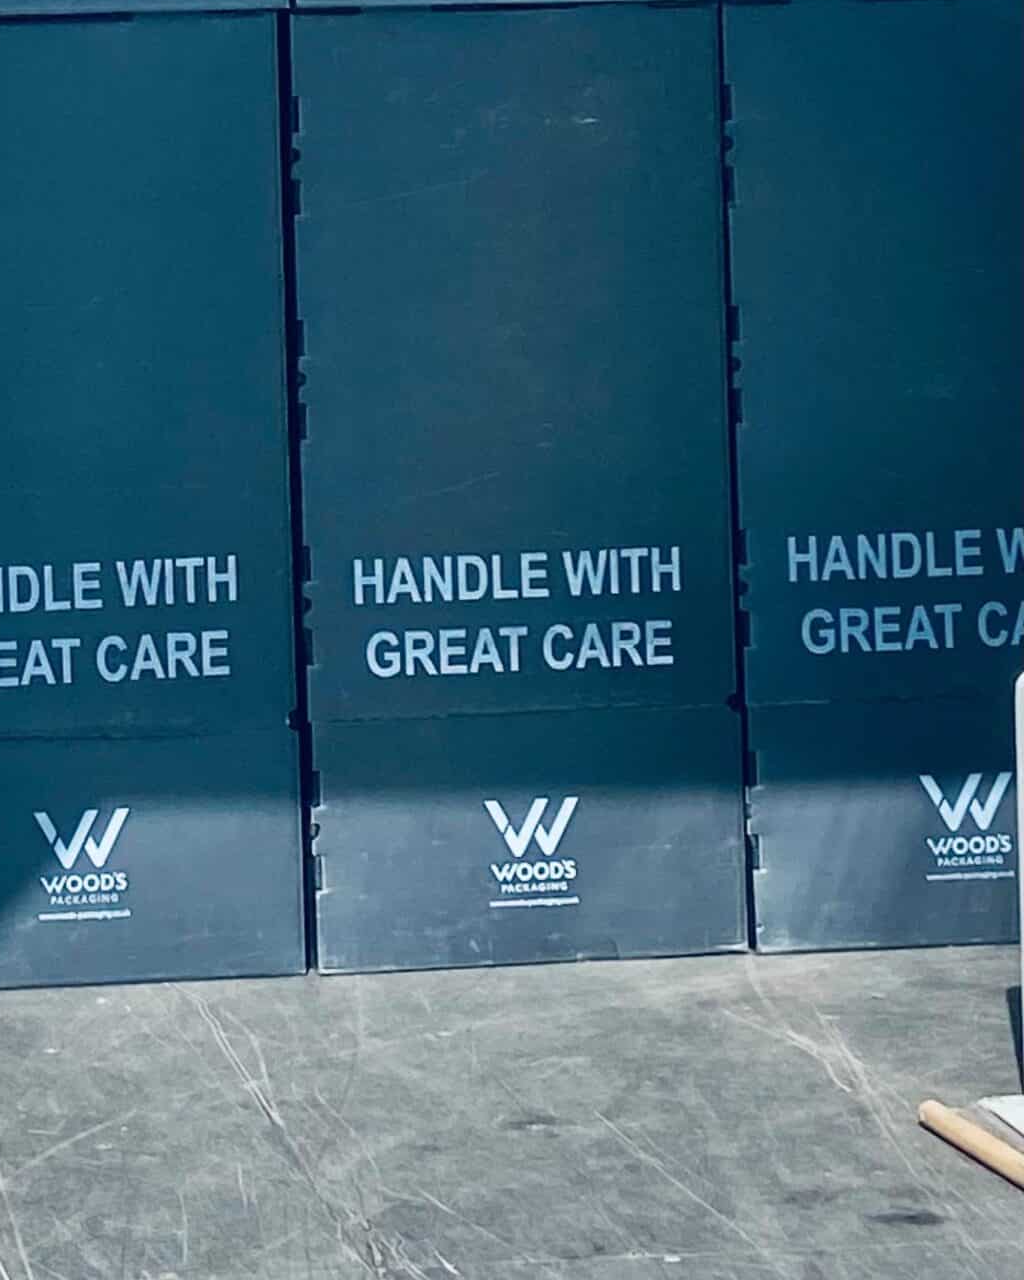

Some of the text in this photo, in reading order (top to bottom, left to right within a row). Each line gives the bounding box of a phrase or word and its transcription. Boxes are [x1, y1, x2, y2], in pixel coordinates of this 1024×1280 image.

[788, 530, 983, 582] HANDLE
[116, 555, 236, 606] WITH
[354, 547, 680, 604] HANDLE WITH
[802, 604, 962, 654] GREAT
[97, 630, 230, 681] CARE
[367, 621, 673, 677] GREAT CARE
[927, 834, 1012, 856] WOOD'S
[937, 854, 1004, 866] PACKAGING
[40, 871, 128, 894] WOOD'S
[490, 859, 576, 882] WOOD'S
[500, 881, 568, 893] PACKAGING
[50, 893, 119, 905] PACKAGING
